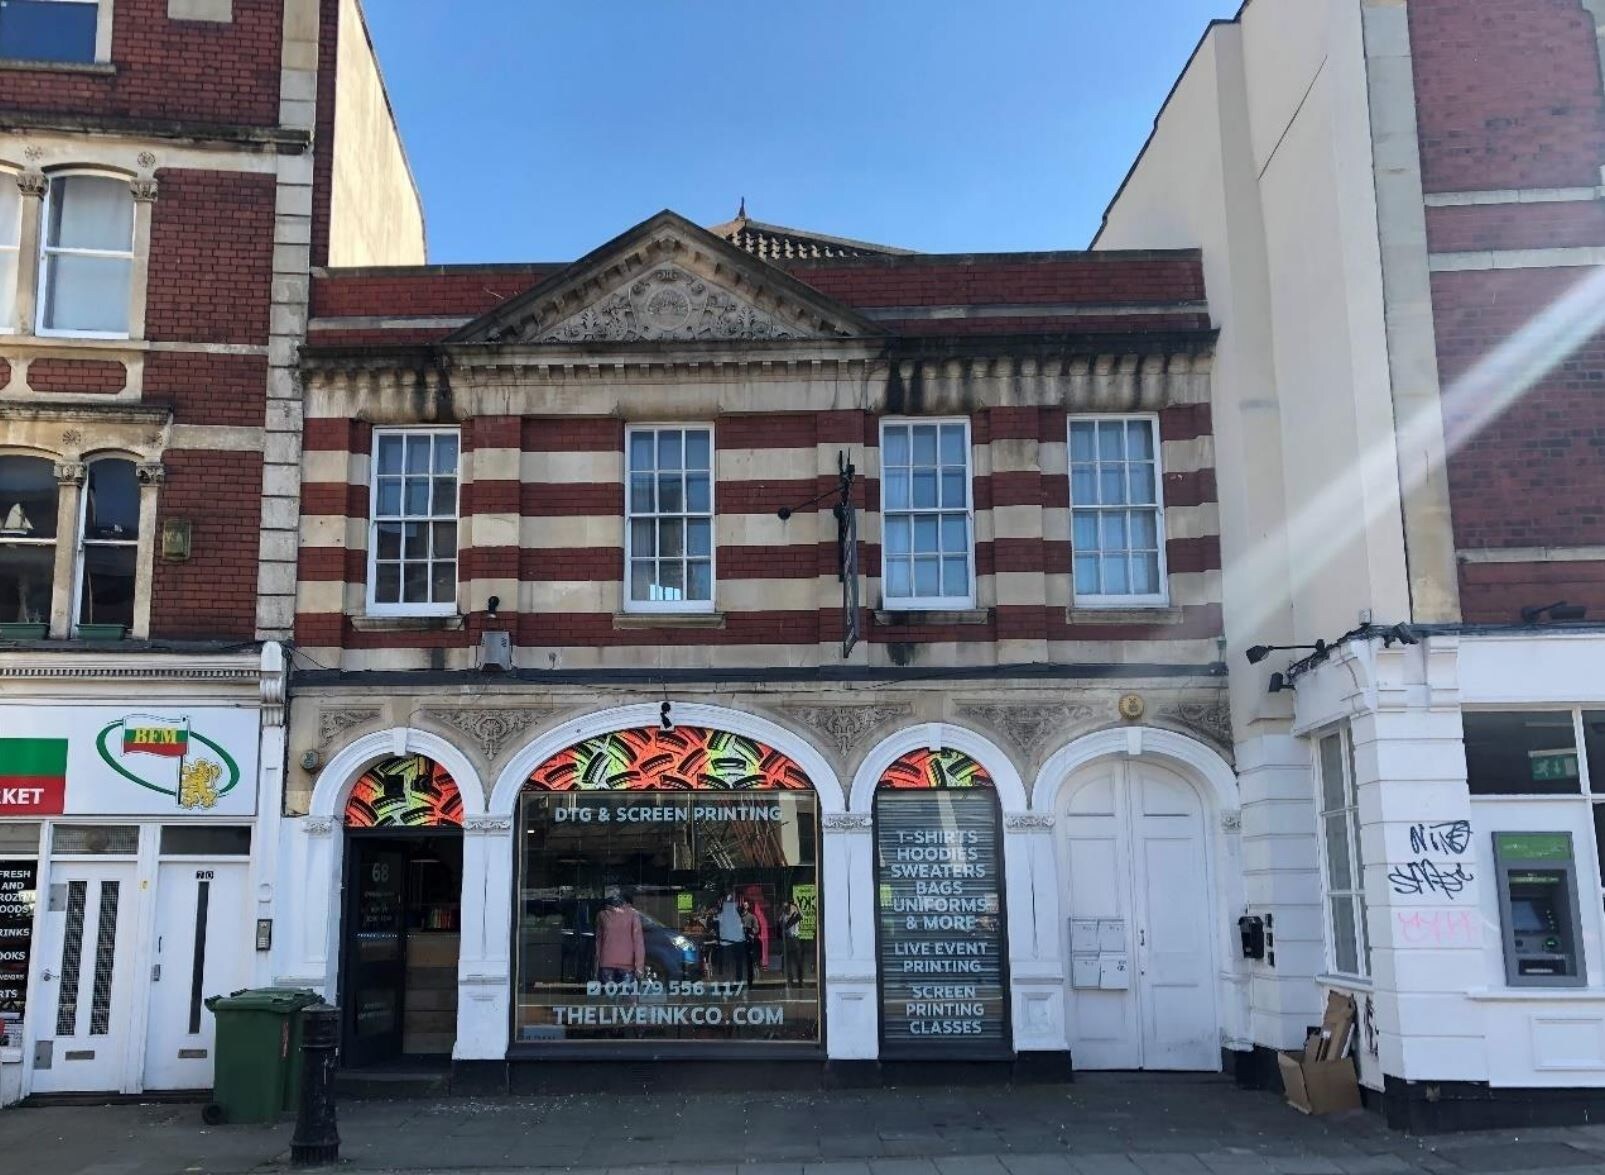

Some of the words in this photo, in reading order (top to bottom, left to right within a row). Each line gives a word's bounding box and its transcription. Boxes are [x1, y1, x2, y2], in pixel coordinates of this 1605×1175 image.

[133, 728, 178, 744] BFM
[0, 788, 44, 804] KET
[555, 807, 592, 822] DTG
[598, 807, 610, 821] &
[616, 807, 687, 822] SCREEN
[694, 807, 782, 821] PRINTING
[897, 830, 978, 843] T-SHIRTS
[897, 847, 978, 861] HOODIES
[891, 863, 986, 878] SWEATERS
[1, 881, 25, 890] AND
[916, 880, 963, 895] BAGS
[893, 897, 988, 912] UNIFORMS
[906, 915, 918, 930] &
[924, 914, 977, 931] MORE
[894, 942, 931, 955] LIVE
[935, 942, 988, 955] EVENT
[903, 960, 982, 973] PRINTING
[605, 981, 664, 996] 01179
[710, 981, 745, 996] 117
[912, 985, 977, 999] SCREEN
[906, 1003, 985, 1017] PRINTING
[909, 1020, 982, 1034] CLASSES
